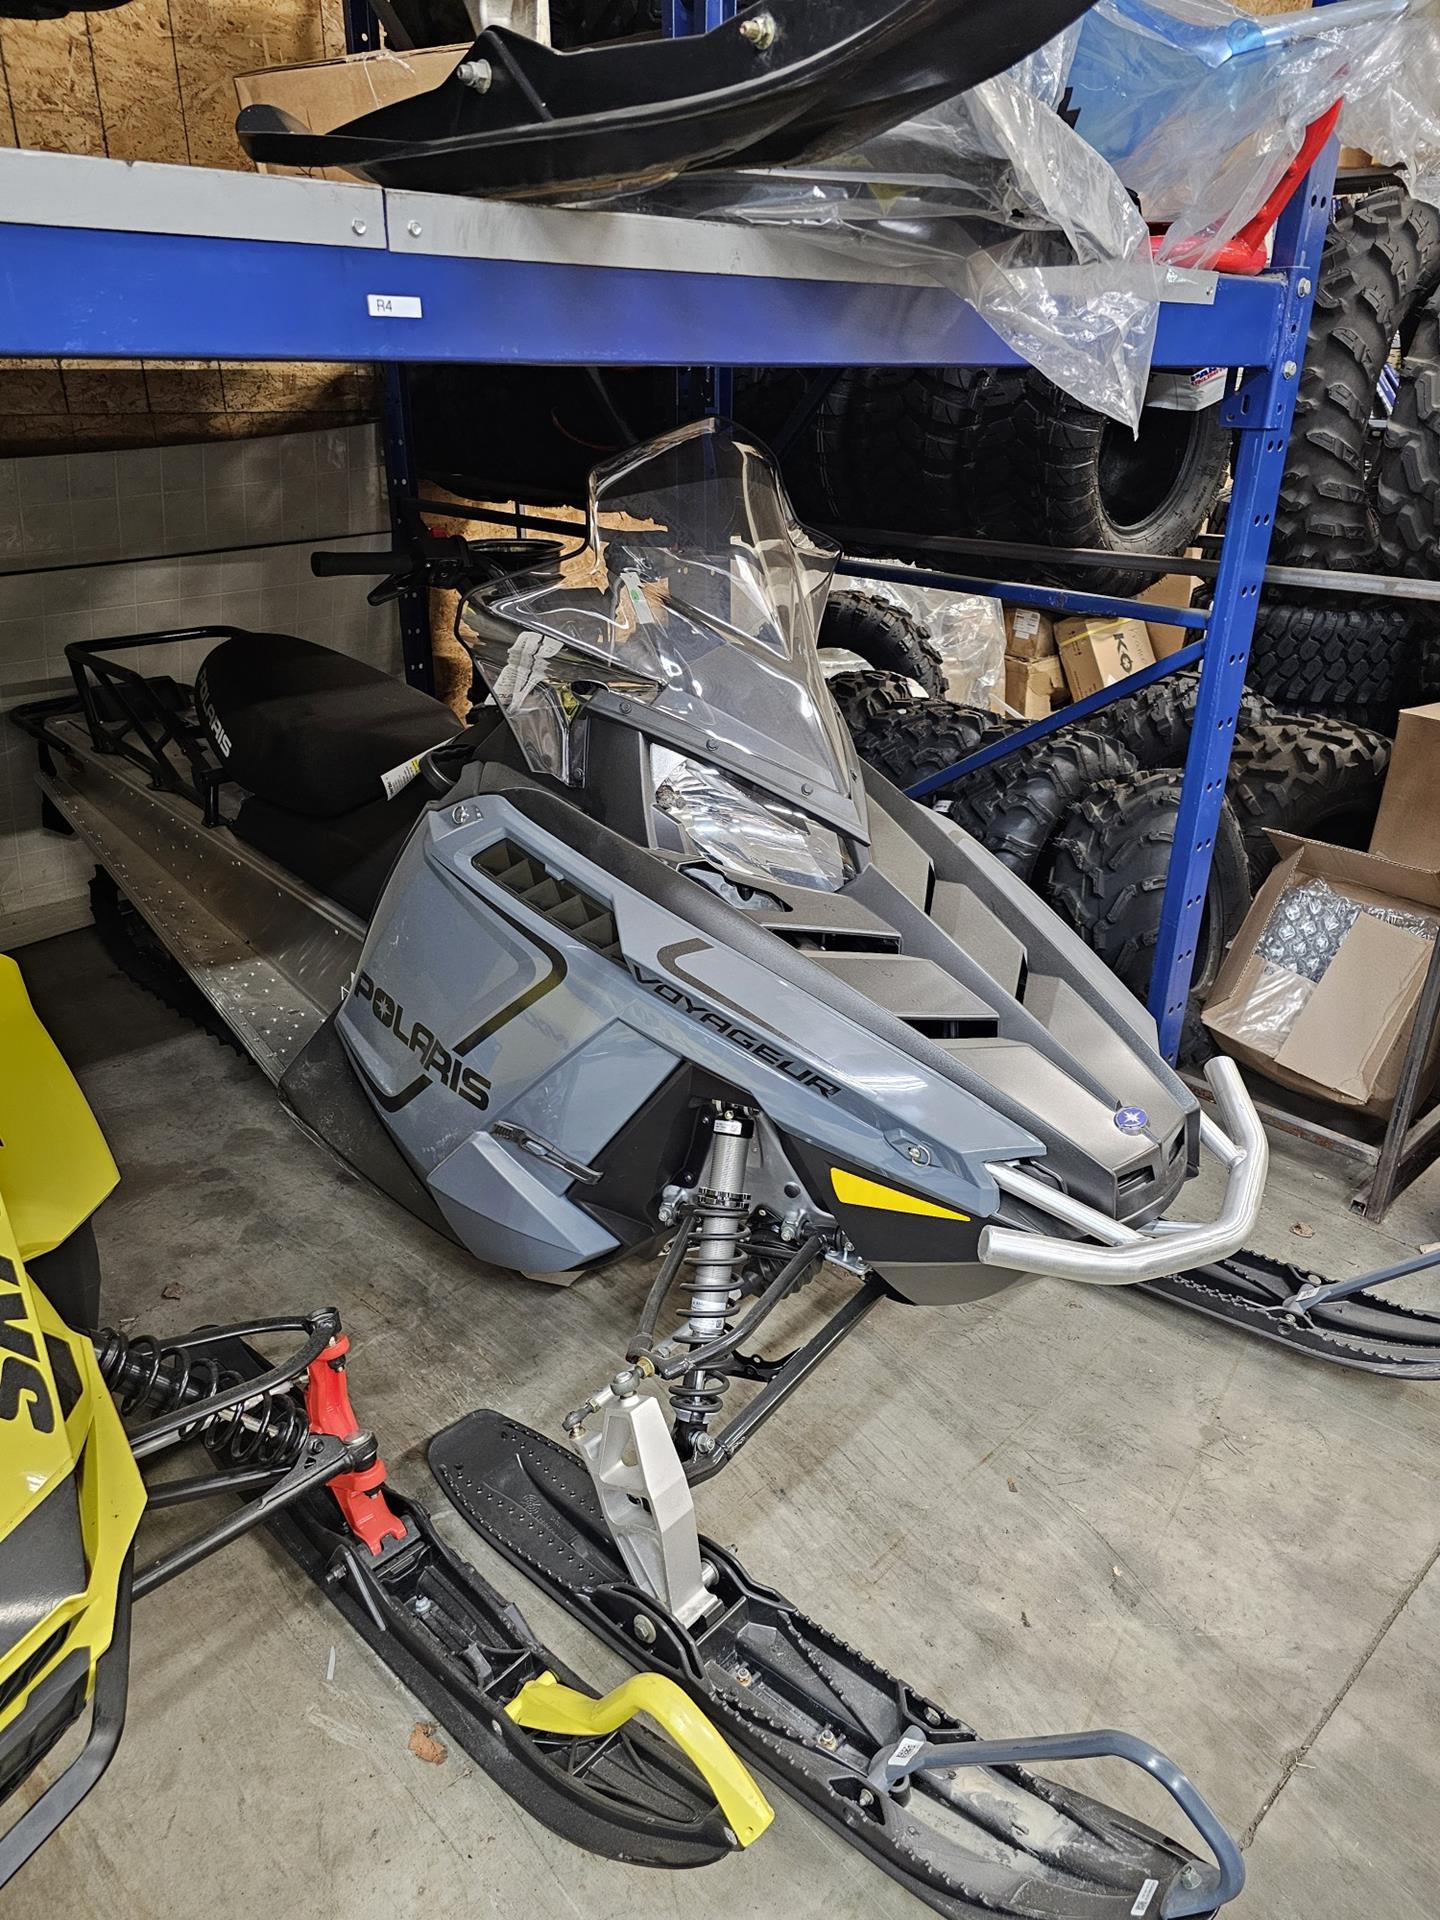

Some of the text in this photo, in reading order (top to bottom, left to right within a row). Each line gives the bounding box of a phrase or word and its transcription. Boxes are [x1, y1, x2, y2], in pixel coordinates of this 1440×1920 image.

[376, 298, 392, 312] R4
[200, 666, 232, 758] POLARIS
[354, 970, 492, 1112] POLARIS
[633, 965, 842, 1099] VOYAGEUR
